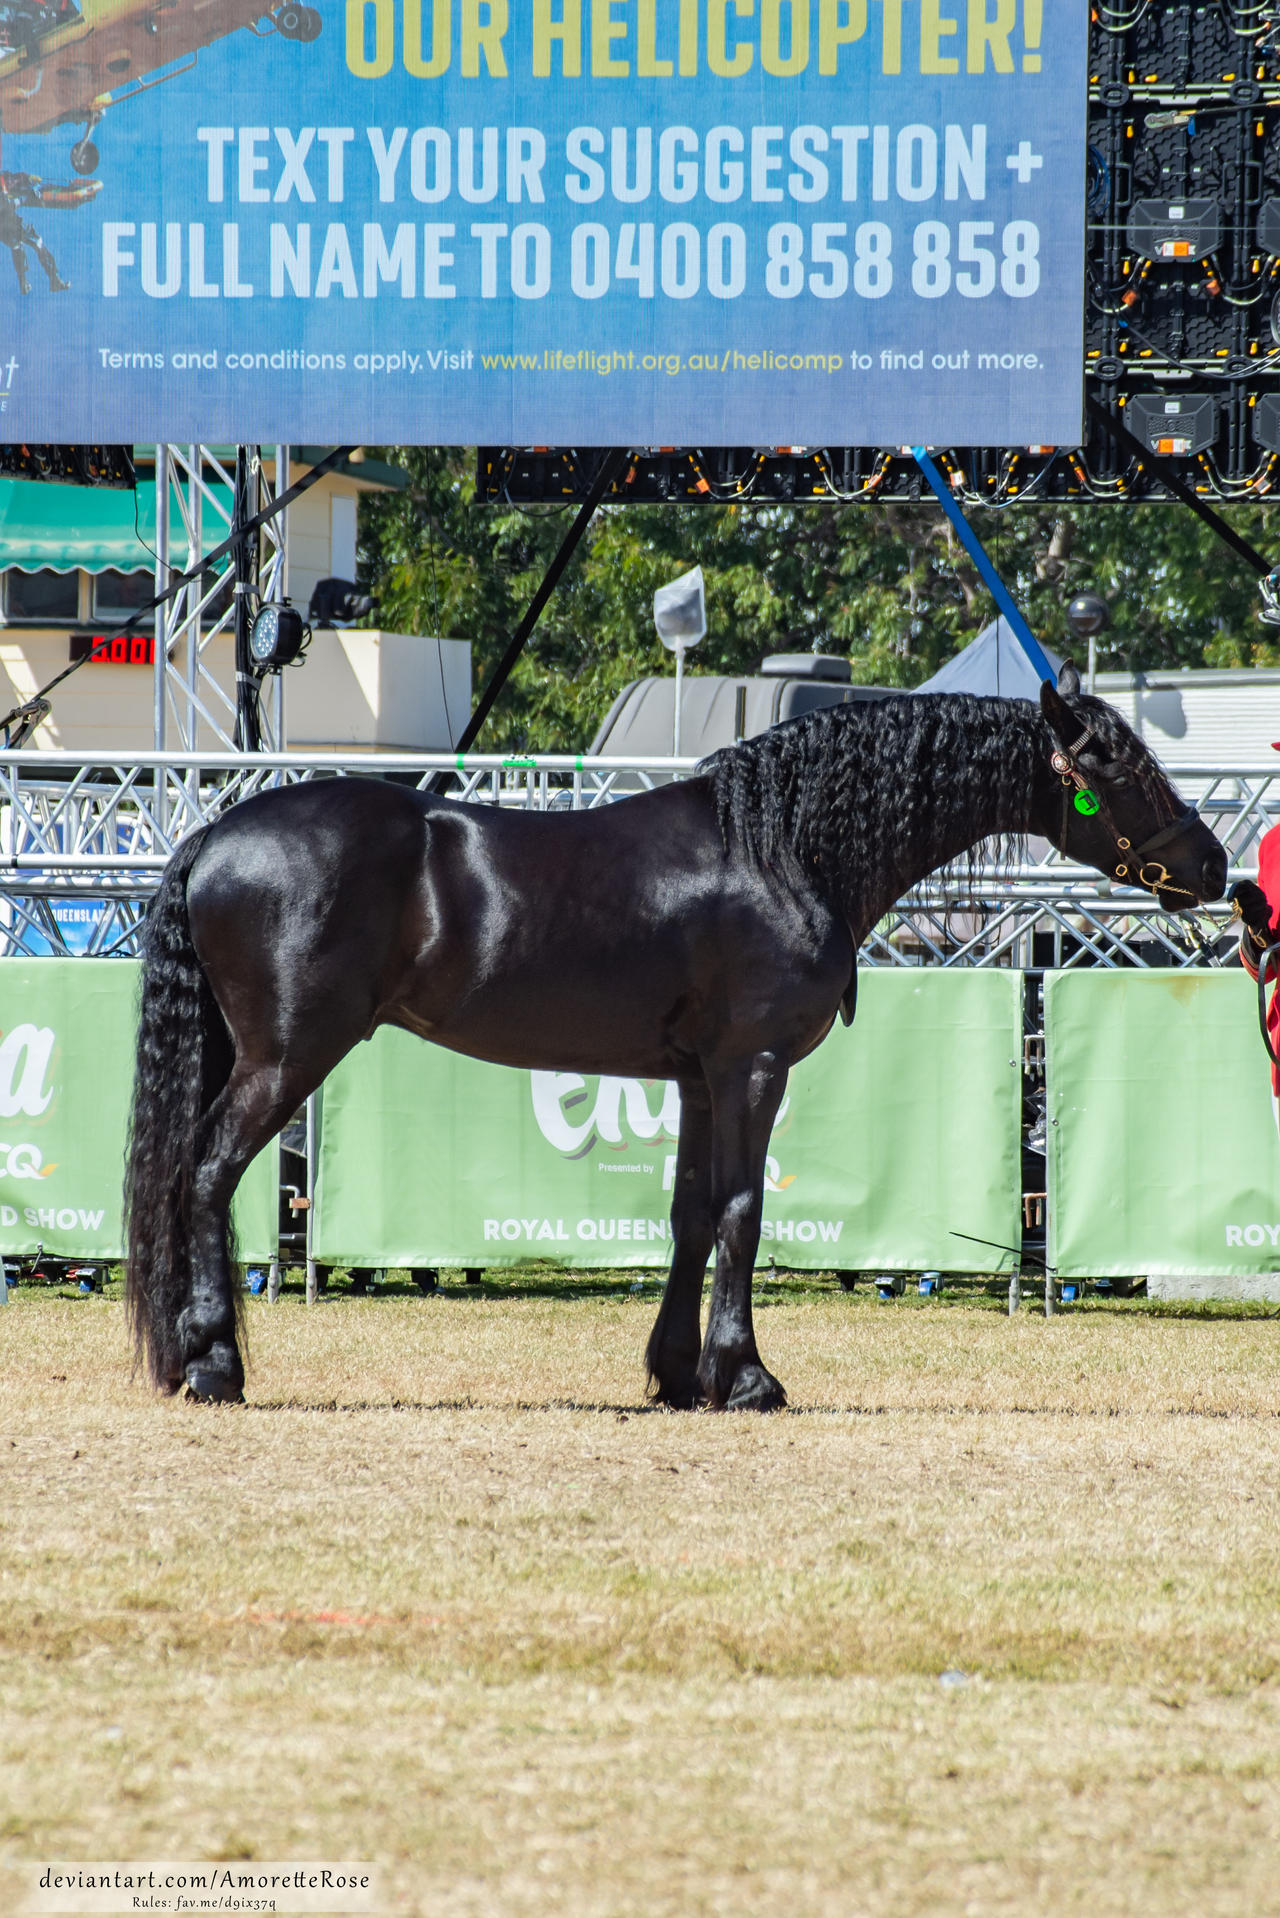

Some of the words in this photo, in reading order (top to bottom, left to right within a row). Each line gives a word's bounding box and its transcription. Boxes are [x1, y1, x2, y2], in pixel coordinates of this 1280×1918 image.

[347, 0, 509, 79] OUR
[534, 0, 1044, 78] HELICOPTER!
[198, 127, 356, 204] TEXT
[367, 127, 547, 205] YOUR
[566, 125, 988, 205] SUGGESTION
[103, 223, 255, 299] FULL
[271, 223, 458, 300] NAME
[471, 224, 552, 300] TO
[571, 223, 748, 300] 0400
[766, 222, 894, 300] 858
[912, 221, 1042, 300] 858
[98, 348, 166, 371] Terms
[172, 349, 219, 371] and
[226, 349, 347, 371] conditions
[354, 350, 424, 375] apply.
[426, 350, 475, 371] Visit
[481, 350, 845, 377] www.lifeflight.org.au/helicomp
[851, 351, 874, 371] to
[881, 350, 925, 371] find
[932, 350, 972, 371] out
[978, 354, 1045, 371] more.
[598, 1162, 641, 1174] Presented
[642, 1162, 655, 1176] by
[24, 1207, 105, 1231] SHOW
[484, 1218, 570, 1241] ROYAL
[761, 1220, 844, 1243] SHOW
